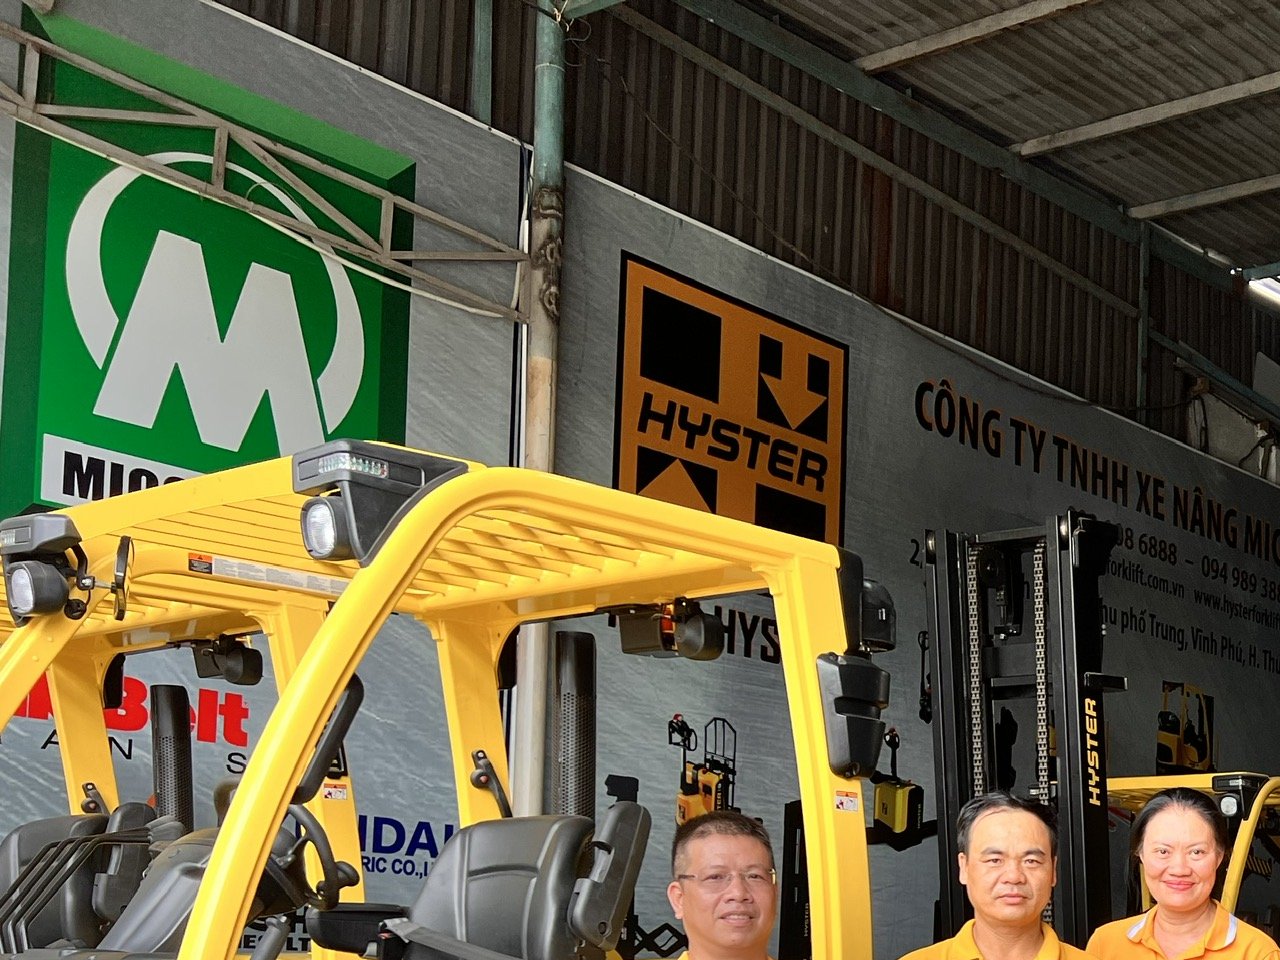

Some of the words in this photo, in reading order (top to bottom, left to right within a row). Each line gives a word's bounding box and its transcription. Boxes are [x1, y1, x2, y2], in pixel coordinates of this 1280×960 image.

[637, 391, 828, 492] HYSTER
[915, 379, 1003, 459] CÔNG
[1009, 416, 1047, 474] TY
[1052, 434, 1129, 508] TNHH
[1135, 469, 1165, 521] XE
[1172, 484, 1238, 549] NÂNG
[62, 450, 185, 501] MIC
[1138, 533, 1177, 566] 6888
[1201, 555, 1228, 585] 094
[1232, 567, 1257, 594] 989
[714, 605, 780, 664] HYS
[1100, 597, 1117, 626] hu
[1149, 613, 1188, 652] Trung,
[1249, 644, 1260, 669] H.
[1084, 697, 1101, 806] HYSTER
[361, 855, 387, 873] RIC
